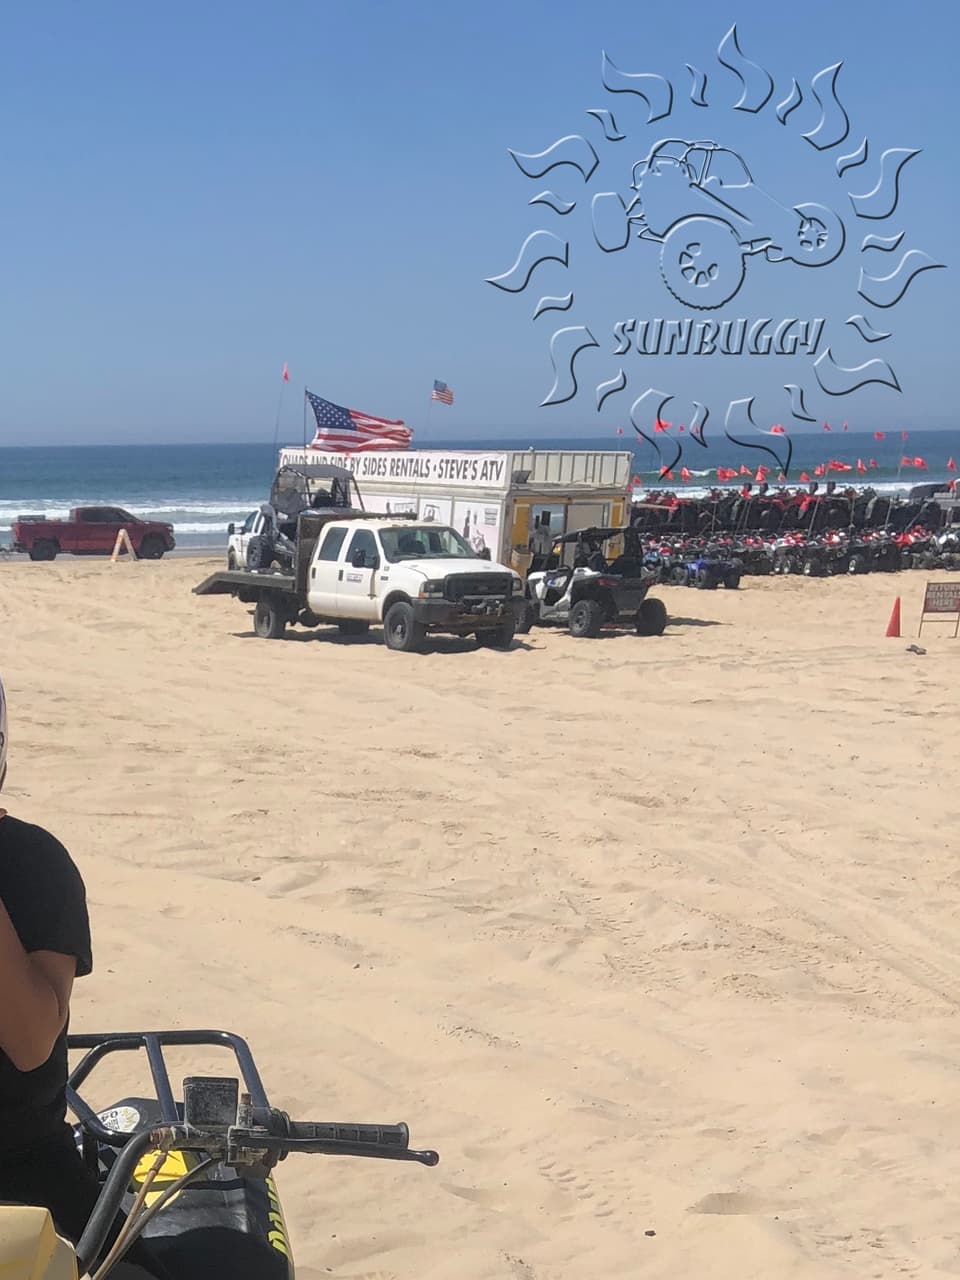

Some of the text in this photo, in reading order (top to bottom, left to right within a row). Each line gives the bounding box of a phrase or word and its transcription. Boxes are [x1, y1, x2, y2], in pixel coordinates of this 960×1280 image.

[362, 457, 387, 476] SIDES
[390, 458, 430, 478] RENTALS
[438, 459, 478, 480] STEVE'S
[480, 460, 504, 480] ATV
